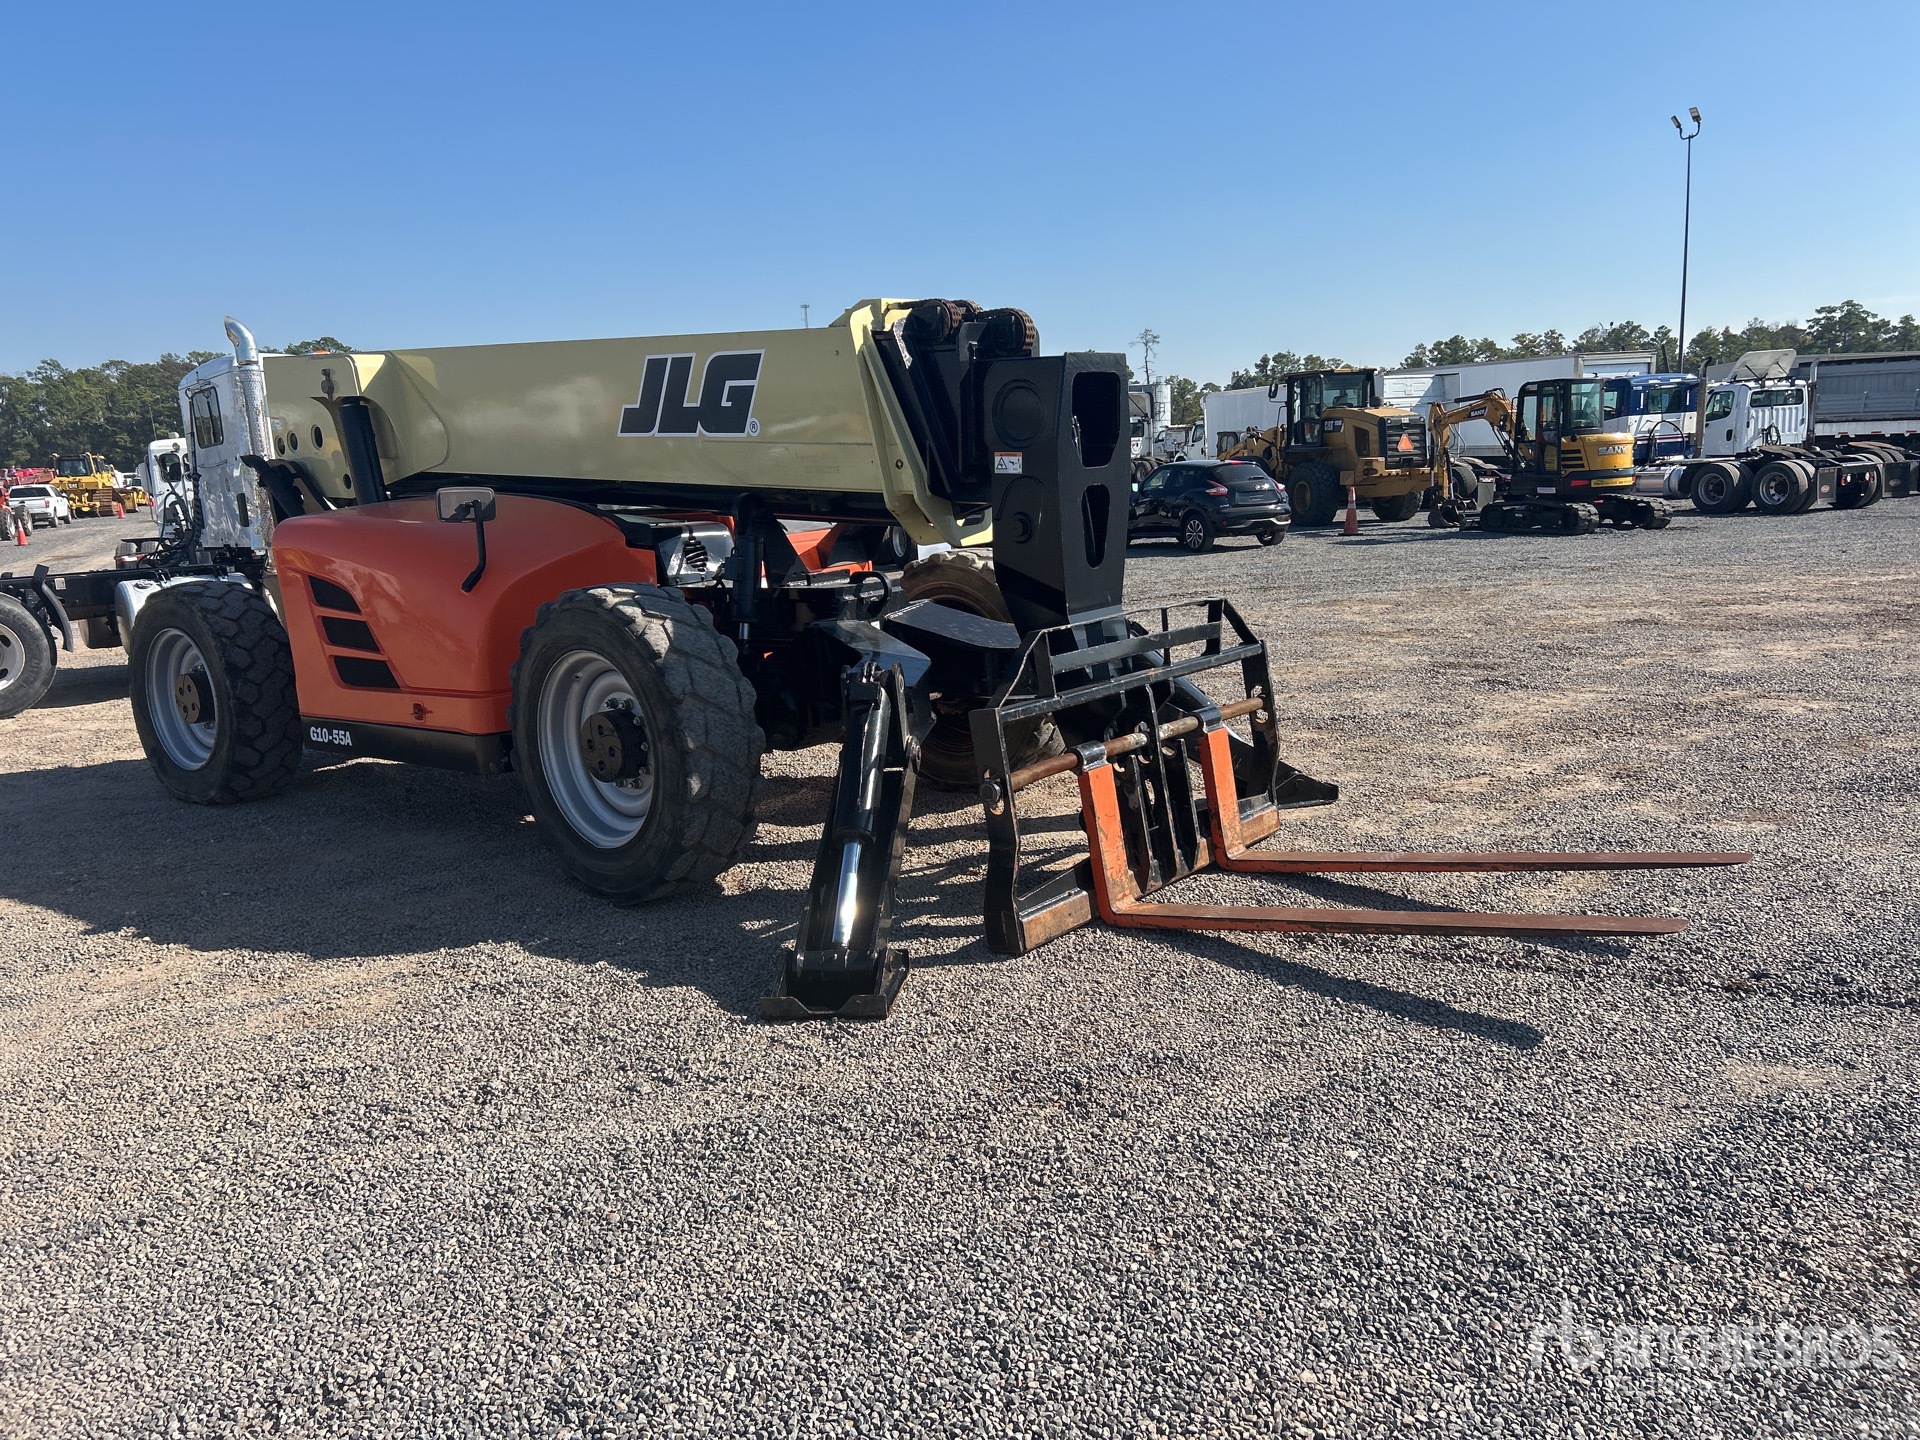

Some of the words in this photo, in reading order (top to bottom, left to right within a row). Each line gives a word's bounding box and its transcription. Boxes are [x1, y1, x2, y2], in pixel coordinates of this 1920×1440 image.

[617, 349, 765, 437] JLG
[1598, 446, 1627, 455] SANY
[310, 726, 352, 746] G10-55A
